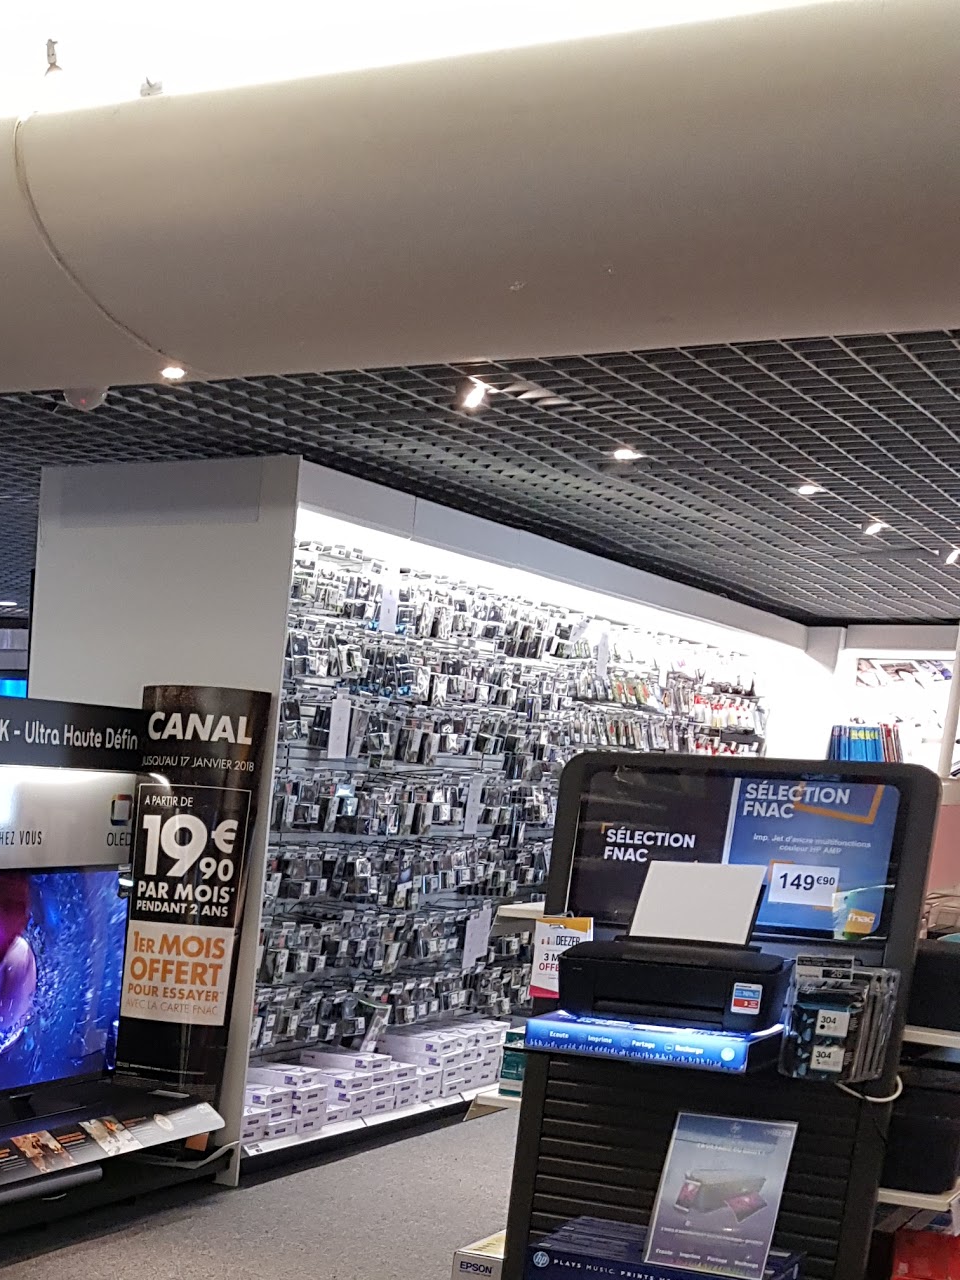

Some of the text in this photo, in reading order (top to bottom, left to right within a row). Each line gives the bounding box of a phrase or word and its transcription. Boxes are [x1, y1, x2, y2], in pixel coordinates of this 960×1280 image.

[25, 720, 60, 745] Ultra
[64, 724, 102, 749] Haute
[148, 711, 253, 746] CANAL
[180, 757, 190, 766] 17
[191, 757, 232, 770] JANVIER
[234, 761, 255, 772] 2018
[745, 781, 851, 805] SÉLECTION
[145, 796, 193, 807] A PARTIR DE
[743, 801, 795, 818] FNAC
[19, 830, 43, 846] VOUS
[106, 832, 132, 847] OLED
[606, 826, 696, 848] SÉLECTION
[603, 846, 649, 862] FNAC
[137, 880, 169, 900] PAR
[136, 900, 228, 917] PENDANT 2 ANS
[848, 913, 875, 924] fnac
[133, 931, 225, 960] 1ER MOIS
[544, 953, 549, 961] 3
[130, 956, 223, 987] OFFERT
[128, 983, 159, 998] POUR
[126, 999, 218, 1015] AVEC LA CARTE FNAC
[820, 1016, 836, 1024] 304
[549, 1031, 570, 1040] Ecoute
[587, 1034, 613, 1045] Imprime
[631, 1039, 656, 1049] Partage
[815, 1051, 831, 1059] 304
[460, 1261, 493, 1275] EPSON
[553, 1258, 582, 1269] PLAYS
[620, 1270, 654, 1280] PRINTS
